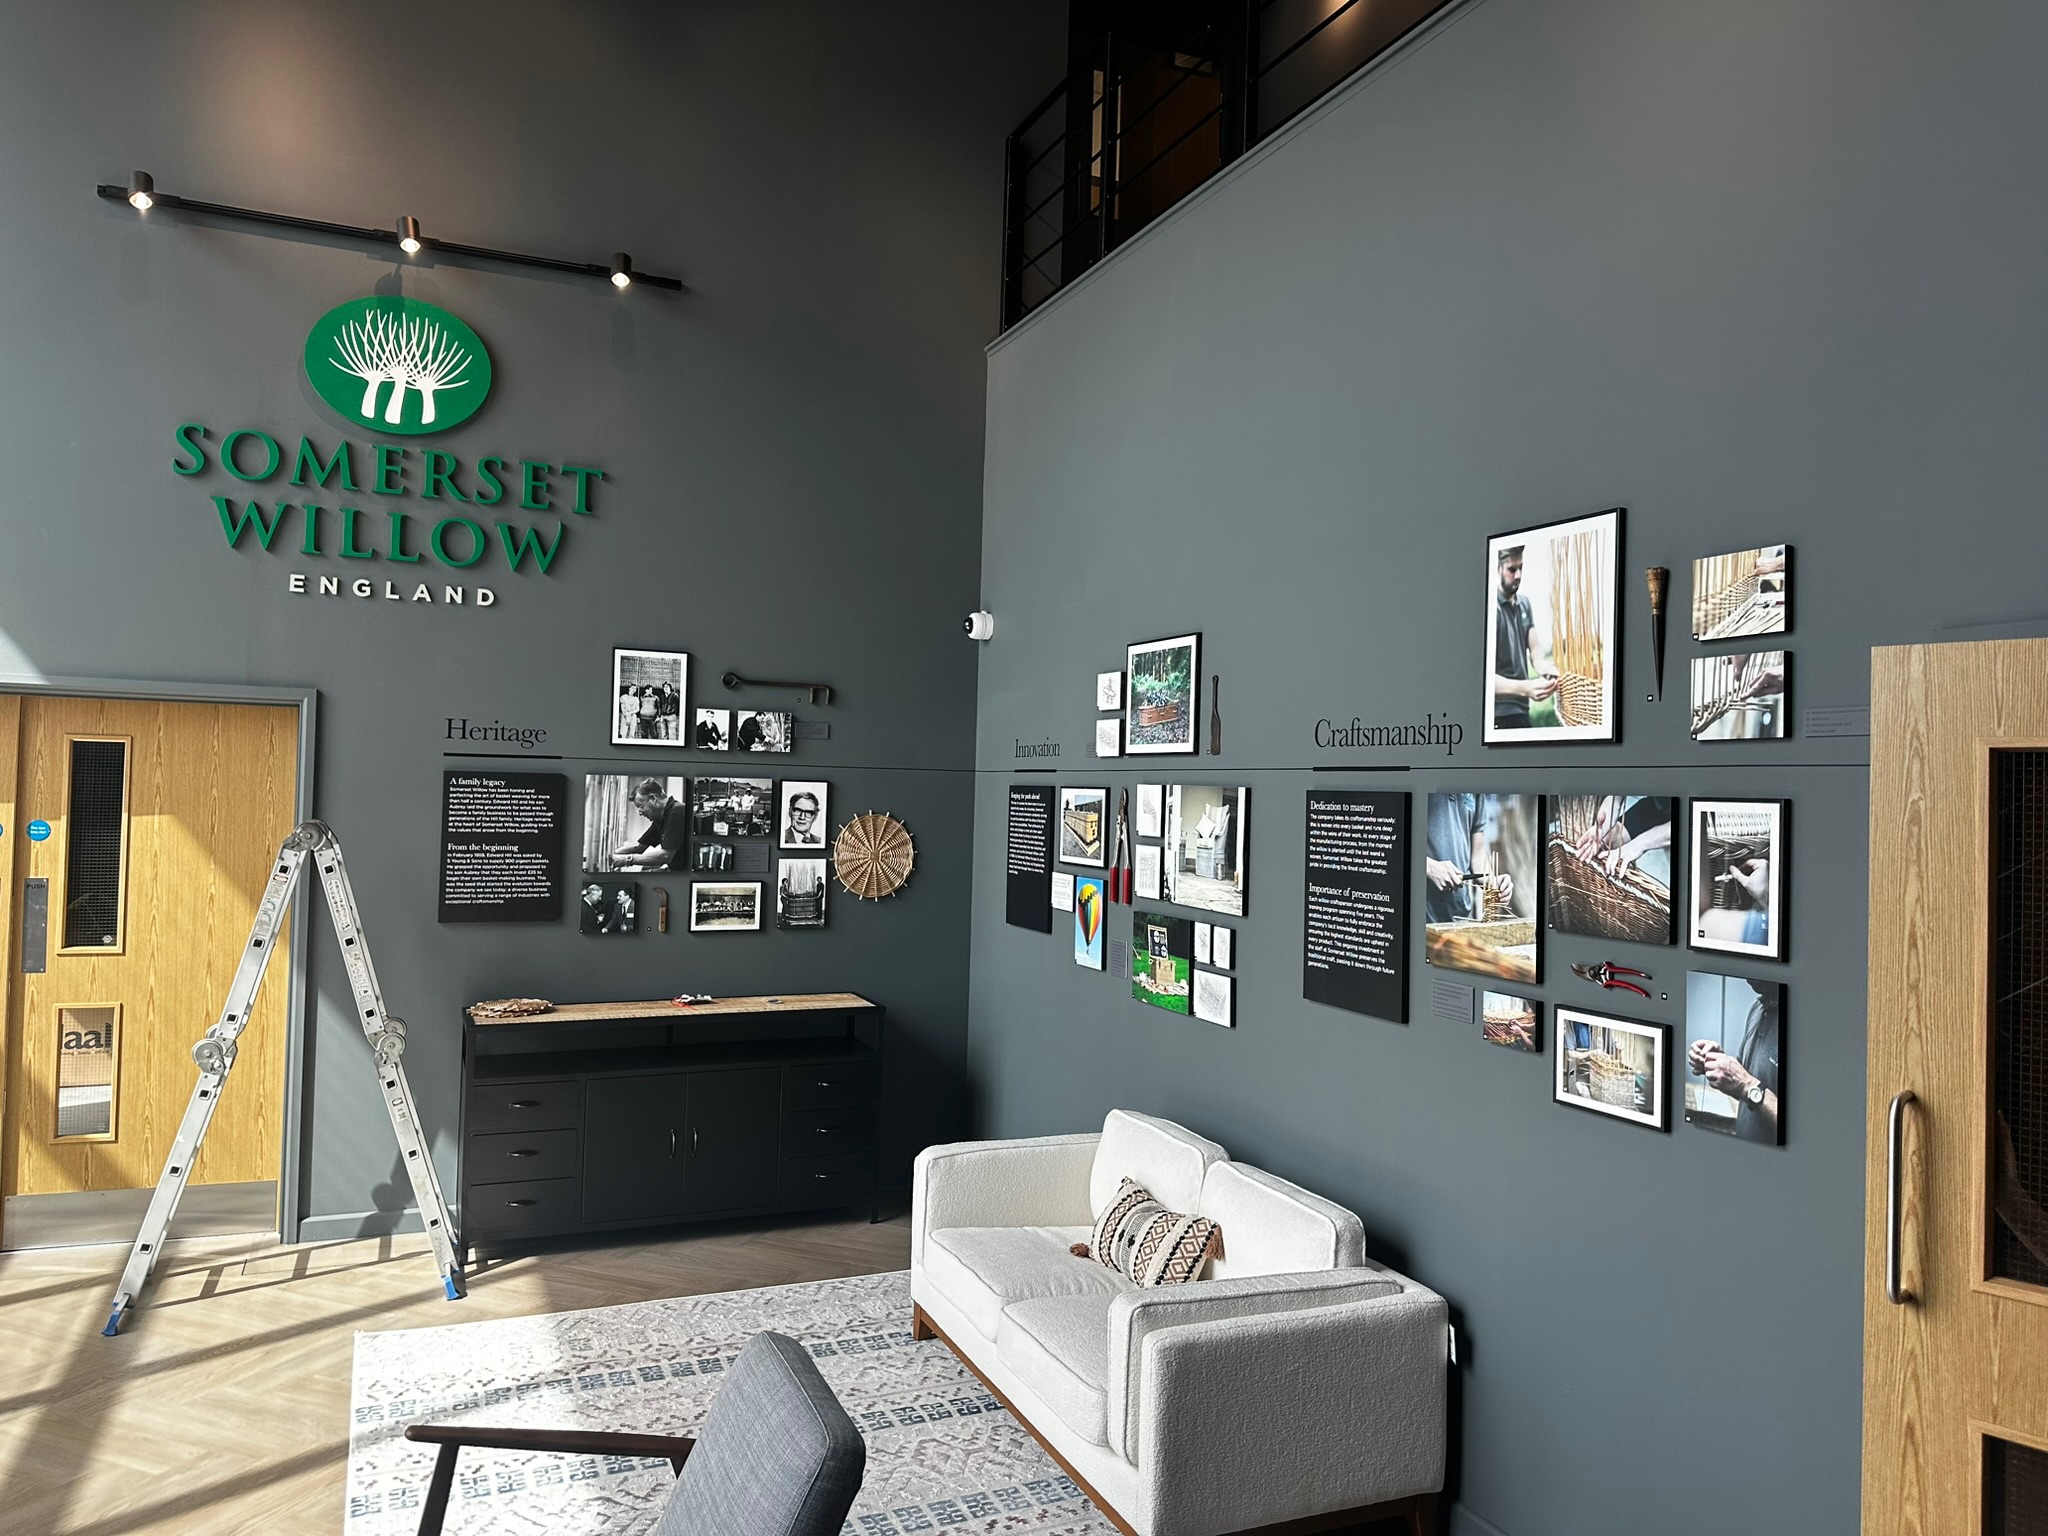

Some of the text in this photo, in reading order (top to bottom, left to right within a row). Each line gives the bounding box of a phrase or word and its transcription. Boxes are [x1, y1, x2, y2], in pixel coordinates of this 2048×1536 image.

[171, 423, 604, 515] SOMERSET
[210, 494, 566, 575] WILLOW
[289, 573, 495, 607] ENGLAND
[444, 717, 547, 749] Heritage
[1314, 713, 1463, 756] Craftsmanship
[1015, 737, 1060, 758] Innovation
[458, 778, 482, 786] family
[482, 778, 506, 787] legacy
[1310, 800, 1374, 814] Dedication to mastery
[482, 843, 518, 852] beginning
[1309, 882, 1390, 902] Importance of preservation
